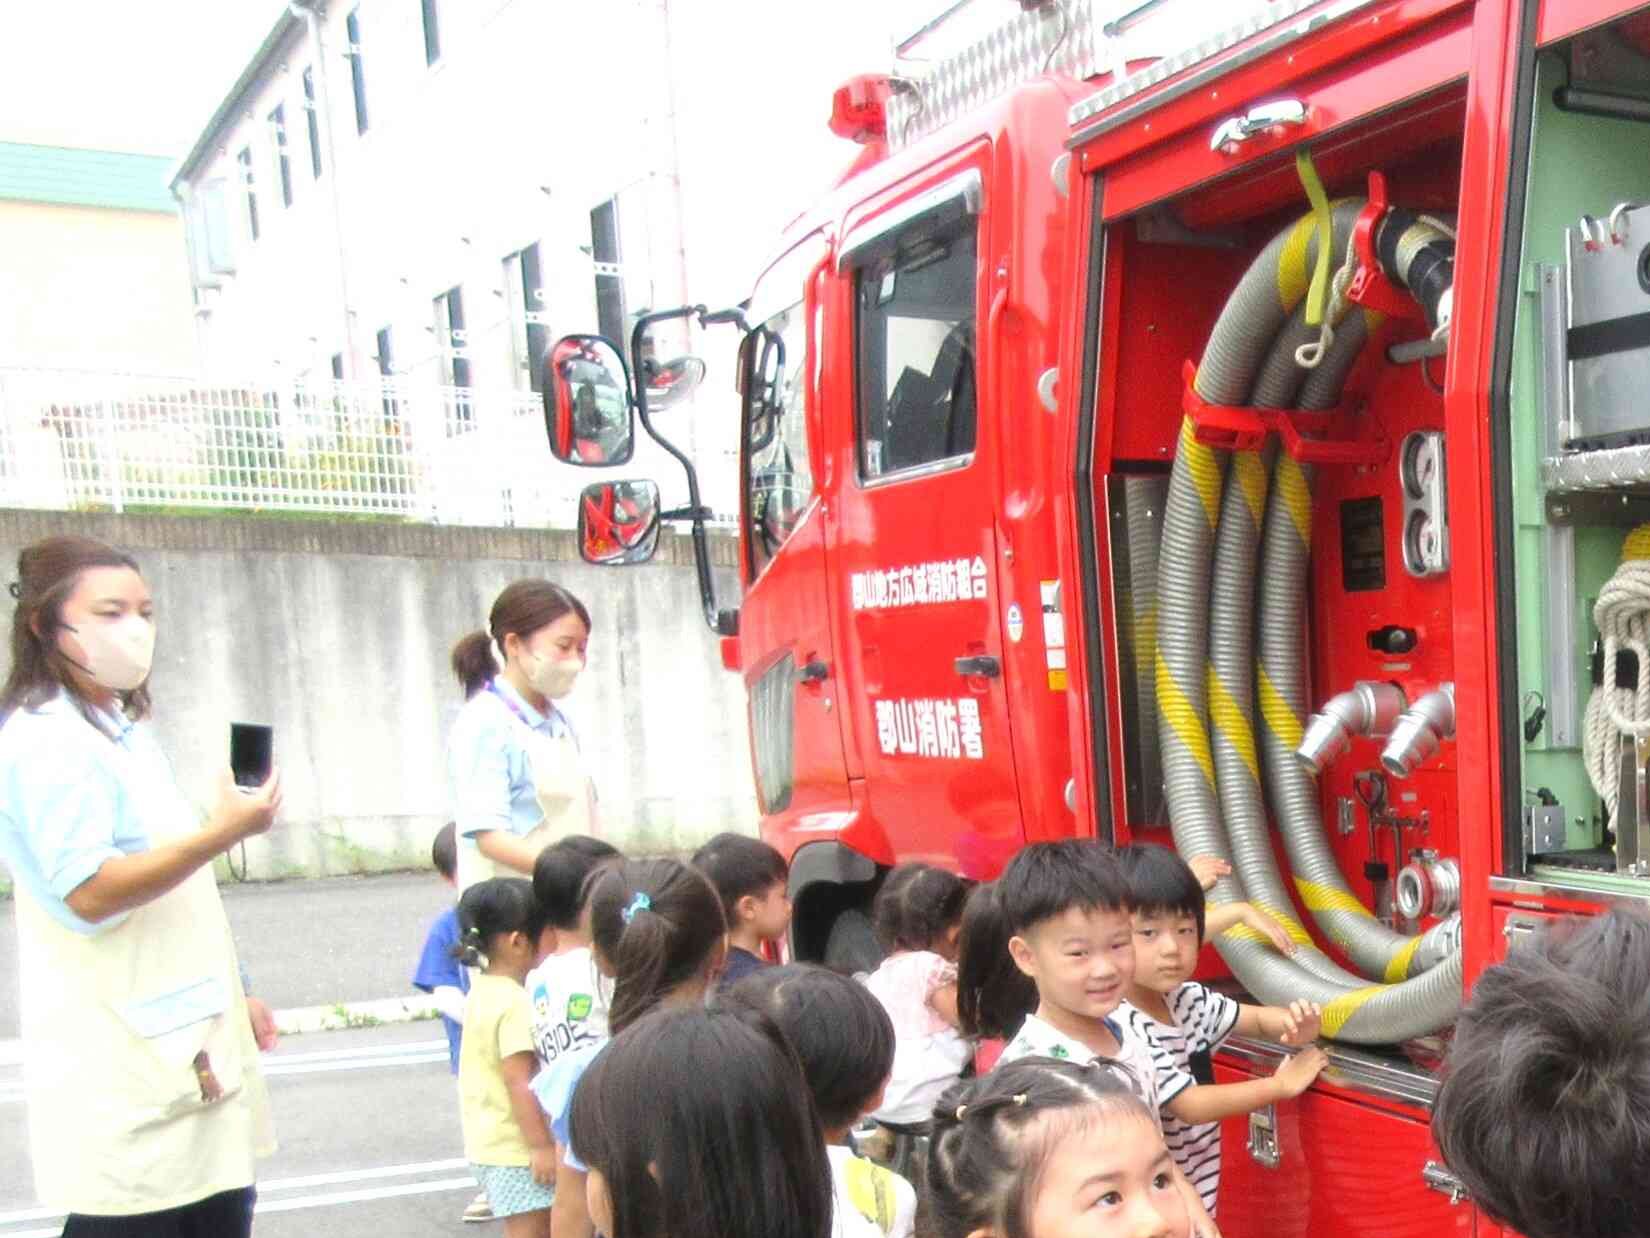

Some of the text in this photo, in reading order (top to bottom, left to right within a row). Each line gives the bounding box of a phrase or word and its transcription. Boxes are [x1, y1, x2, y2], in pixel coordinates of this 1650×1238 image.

[875, 697, 984, 760] 郡山消防署
